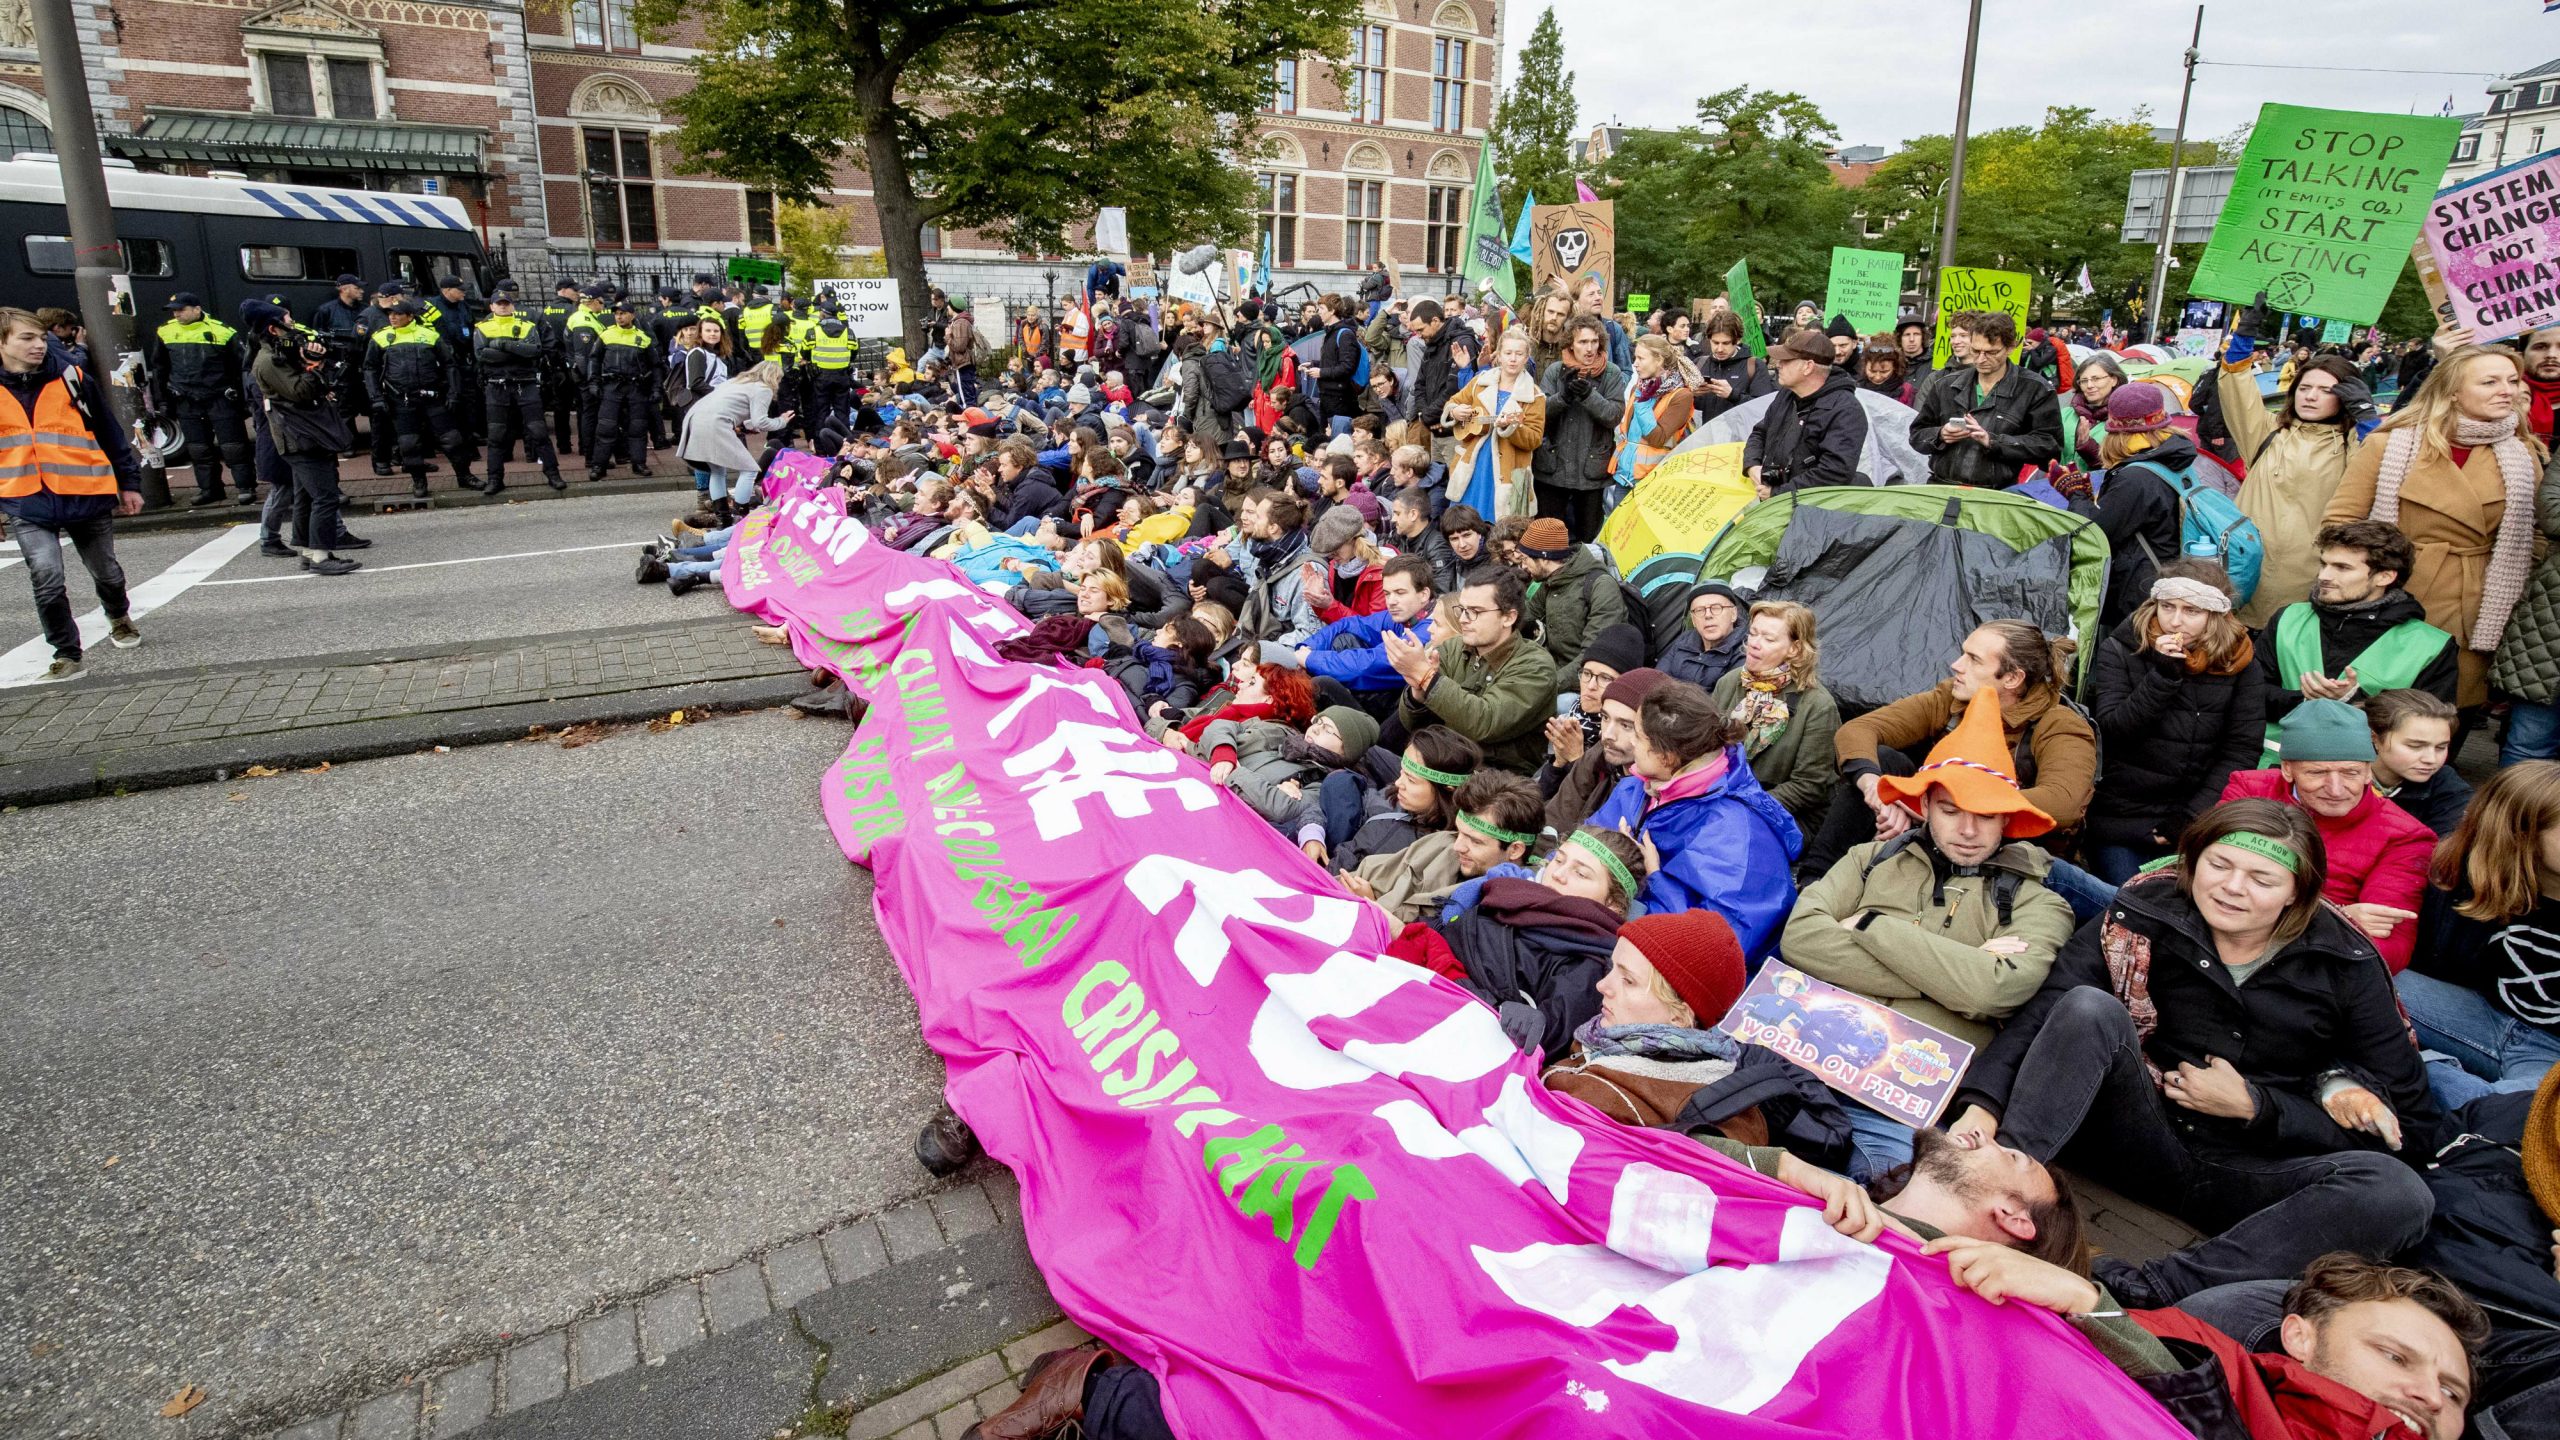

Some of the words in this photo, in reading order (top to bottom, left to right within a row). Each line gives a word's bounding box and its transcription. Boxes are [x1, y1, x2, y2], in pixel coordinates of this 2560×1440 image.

[2295, 128, 2404, 160] STOP
[2261, 159, 2420, 193] TALKING
[2289, 191, 2346, 207] EMITS
[2434, 169, 2555, 228] SYSTEM
[2259, 207, 2386, 242] START
[2239, 238, 2371, 279] ACTING
[2489, 237, 2536, 265] NOT
[1857, 270, 1869, 278] BE
[1867, 258, 1901, 272] RATHER
[831, 281, 856, 289] NOT
[857, 281, 882, 289] YOU
[1837, 278, 1888, 290] SOMEWHERE
[1842, 288, 1862, 296] ELSE
[1947, 269, 1977, 293] IT'S
[2465, 256, 2560, 304] CLIMAT
[835, 292, 857, 300] HO?
[843, 303, 858, 311] OT
[860, 303, 889, 311] NOW
[1943, 286, 1990, 313] GOING
[1992, 281, 2012, 301] TO
[2476, 287, 2560, 327] CHAN
[1837, 308, 1886, 321] IMPORTANT
[1595, 842, 1607, 855] TELL
[1607, 853, 1618, 865] THE
[2251, 837, 2267, 848] ACT
[2271, 844, 2289, 857] NOW
[1742, 1016, 1819, 1063] WORLD
[1822, 1055, 1858, 1083] ON
[1860, 1073, 1932, 1120] FIRE!
[1895, 1051, 1943, 1081] SAM
